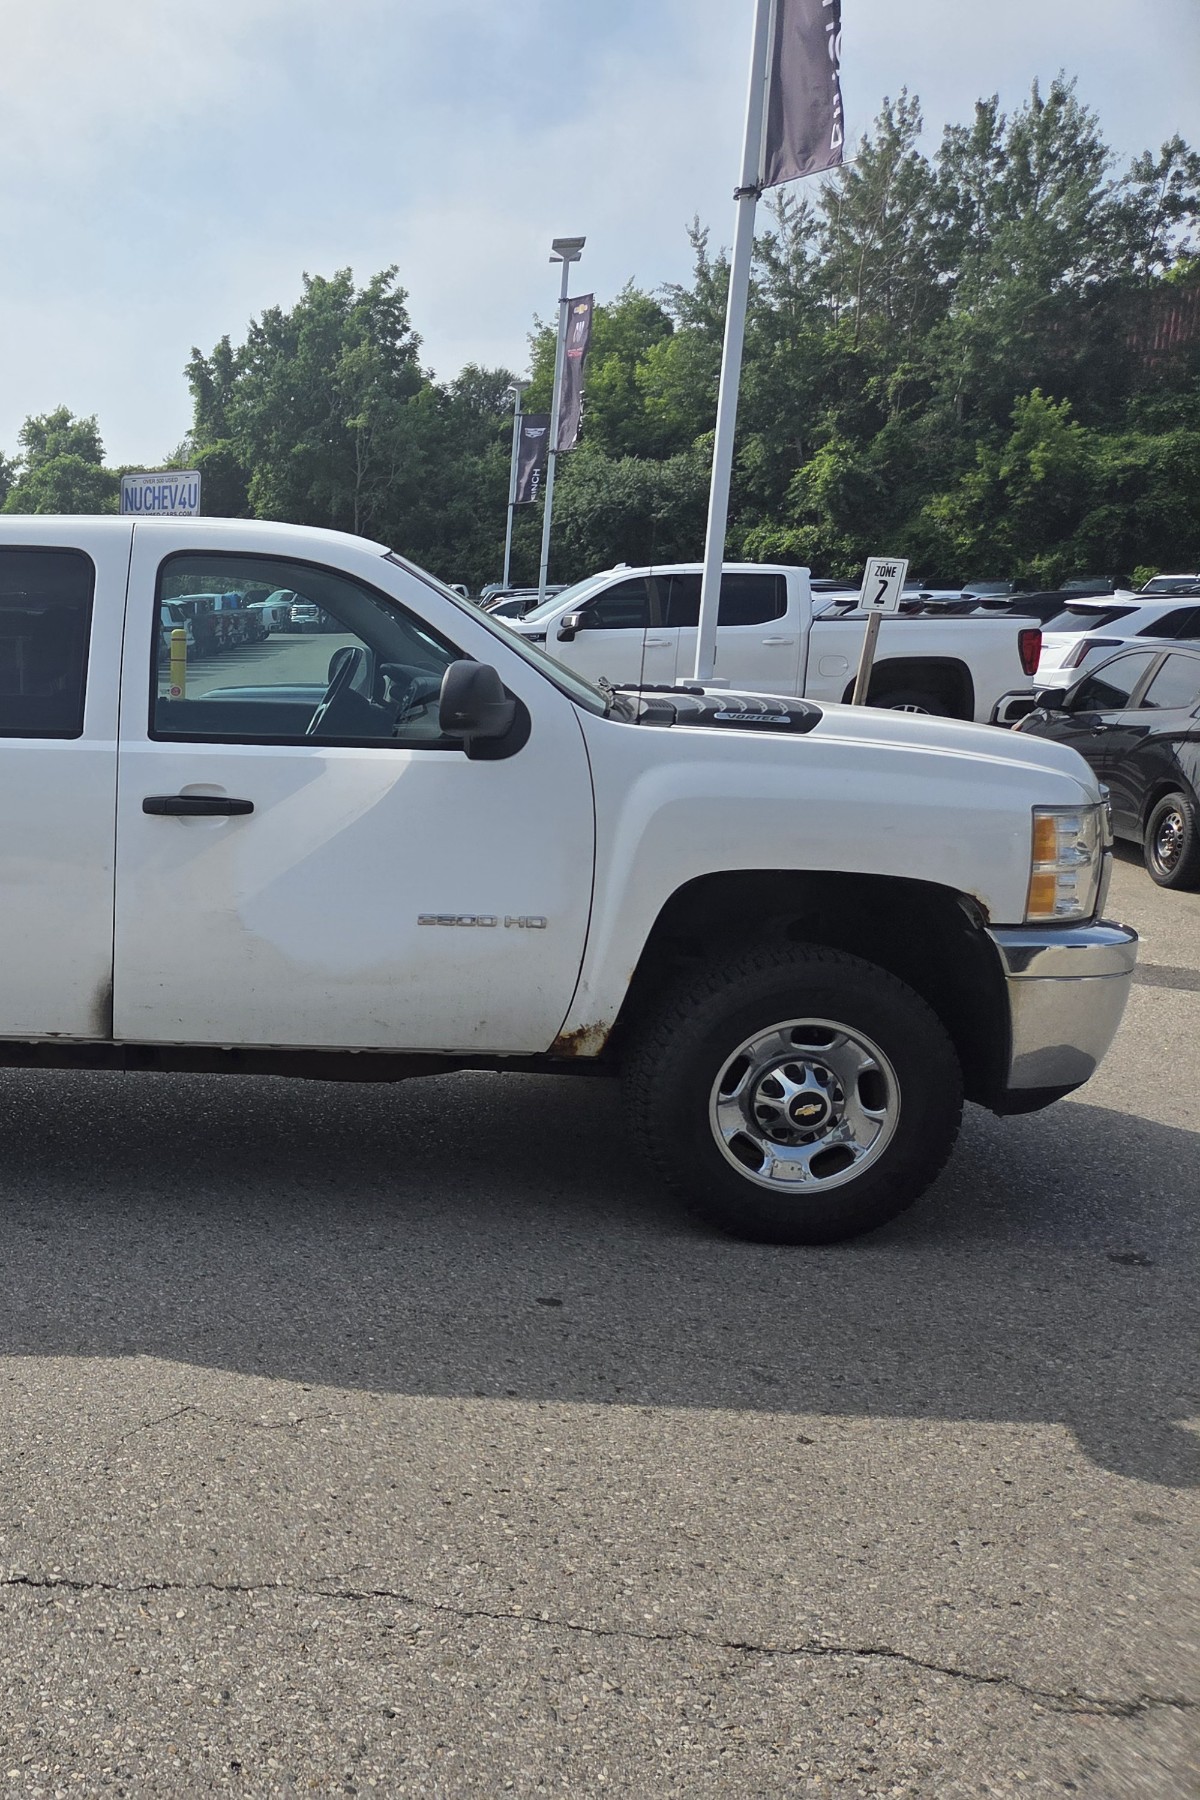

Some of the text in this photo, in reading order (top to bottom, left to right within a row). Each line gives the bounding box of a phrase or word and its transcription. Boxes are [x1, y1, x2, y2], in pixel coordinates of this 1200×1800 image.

[124, 483, 198, 512] NUCHEV4U
[874, 565, 897, 578] ZONE
[873, 579, 889, 605] 2
[727, 713, 781, 722] VORTEC
[417, 913, 548, 929] 2500 HD
